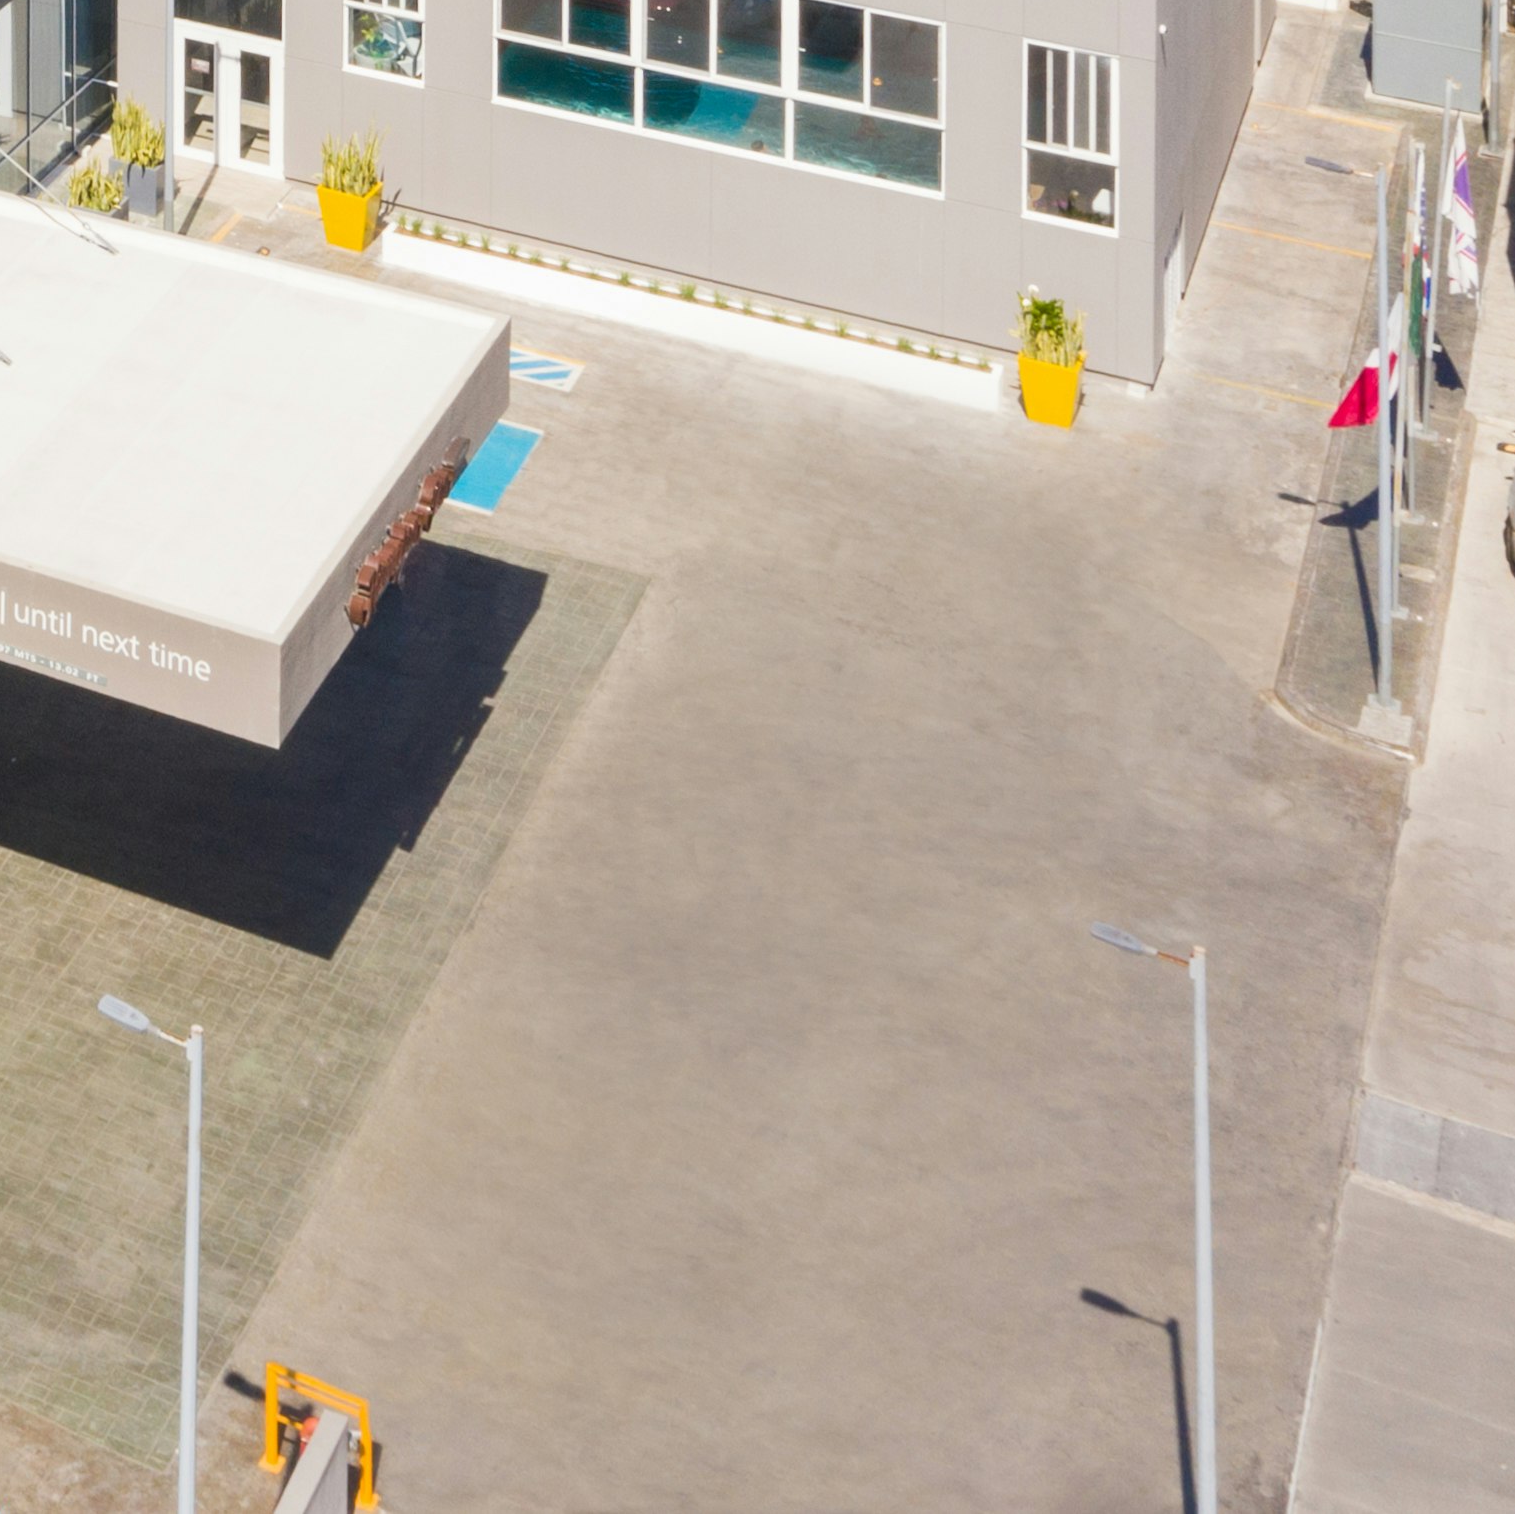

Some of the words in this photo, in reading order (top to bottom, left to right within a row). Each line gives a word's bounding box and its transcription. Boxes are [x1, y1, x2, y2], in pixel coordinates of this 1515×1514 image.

[13, 601, 72, 639] until
[82, 623, 140, 661] next
[148, 640, 212, 682] time
[14, 648, 37, 664] MTS
[85, 669, 100, 684] FT
